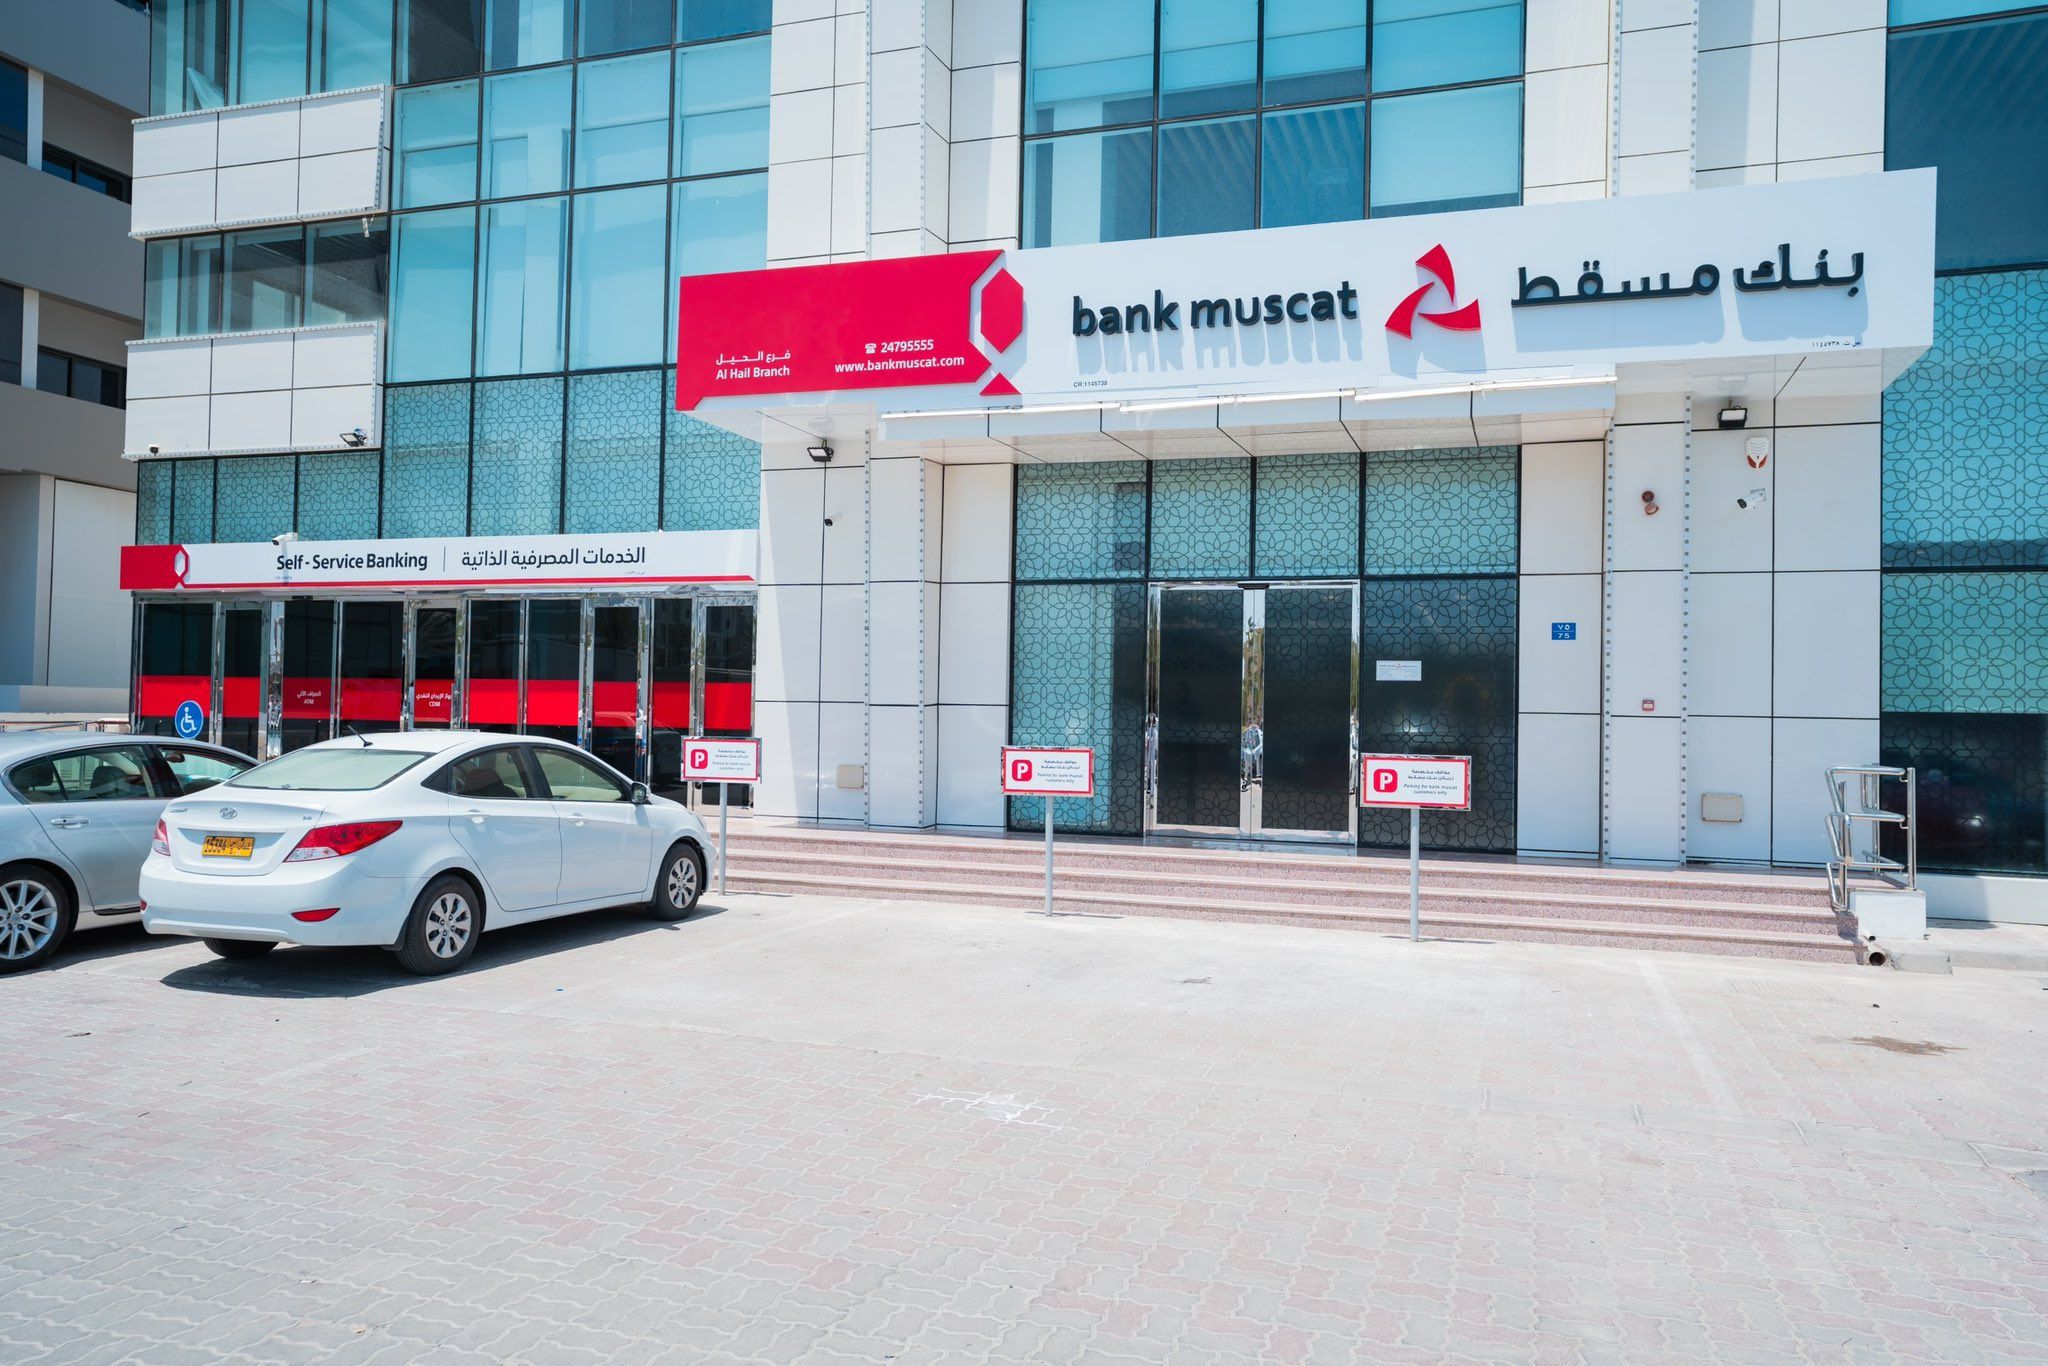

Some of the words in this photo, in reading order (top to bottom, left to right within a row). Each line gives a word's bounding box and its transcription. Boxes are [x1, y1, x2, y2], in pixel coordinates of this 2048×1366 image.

[1733, 243, 1864, 298] بنك
[1511, 260, 1720, 308] مسقط
[1072, 289, 1179, 337] bank
[1191, 281, 1358, 330] muscat
[880, 339, 934, 354] 24795555
[716, 368, 727, 380] Al
[730, 367, 751, 379] Hail
[753, 366, 790, 378] Branch
[834, 355, 965, 373] www.bankmuscat.com
[276, 554, 303, 570] Self
[312, 553, 364, 569] Service
[366, 552, 428, 571] Banking
[462, 550, 507, 571] الذاتية
[511, 548, 579, 570] المصرفية
[583, 546, 646, 565] الخدمات
[694, 752, 705, 767] P
[1017, 763, 1029, 780] P
[1380, 772, 1394, 791] P
